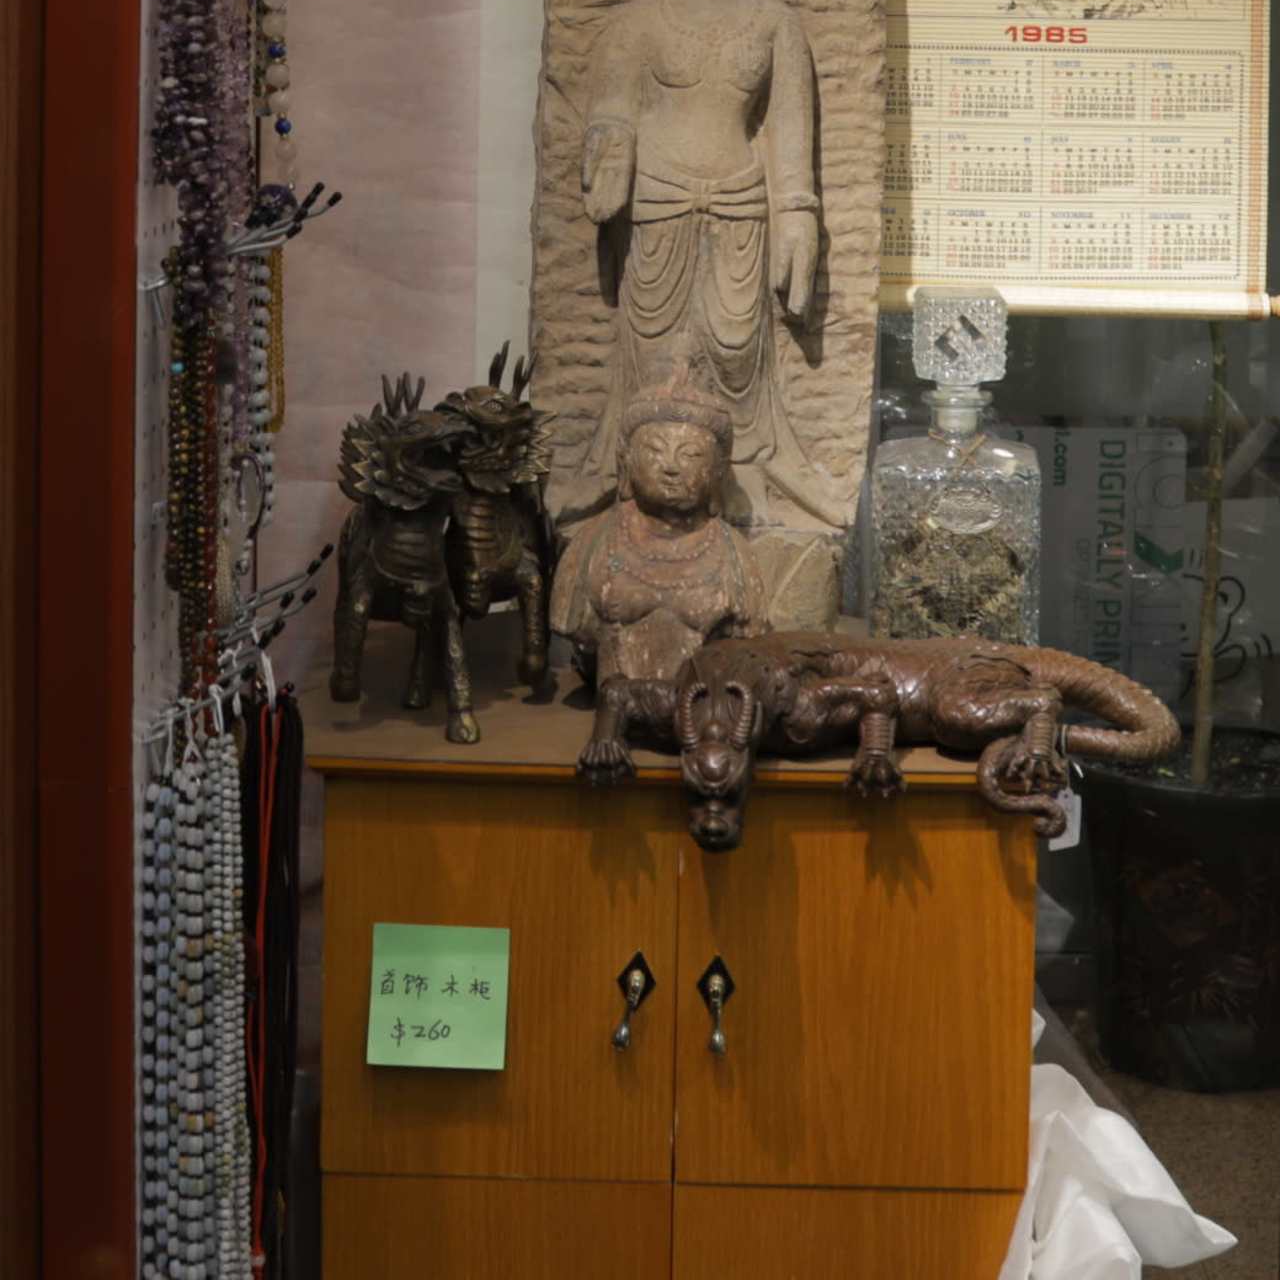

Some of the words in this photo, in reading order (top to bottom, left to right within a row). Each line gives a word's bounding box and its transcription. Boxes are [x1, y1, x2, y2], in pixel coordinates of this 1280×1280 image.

[1005, 25, 1088, 44] 1985
[1095, 439, 1126, 590] DIGITALLY
[390, 1017, 452, 1048] $260
